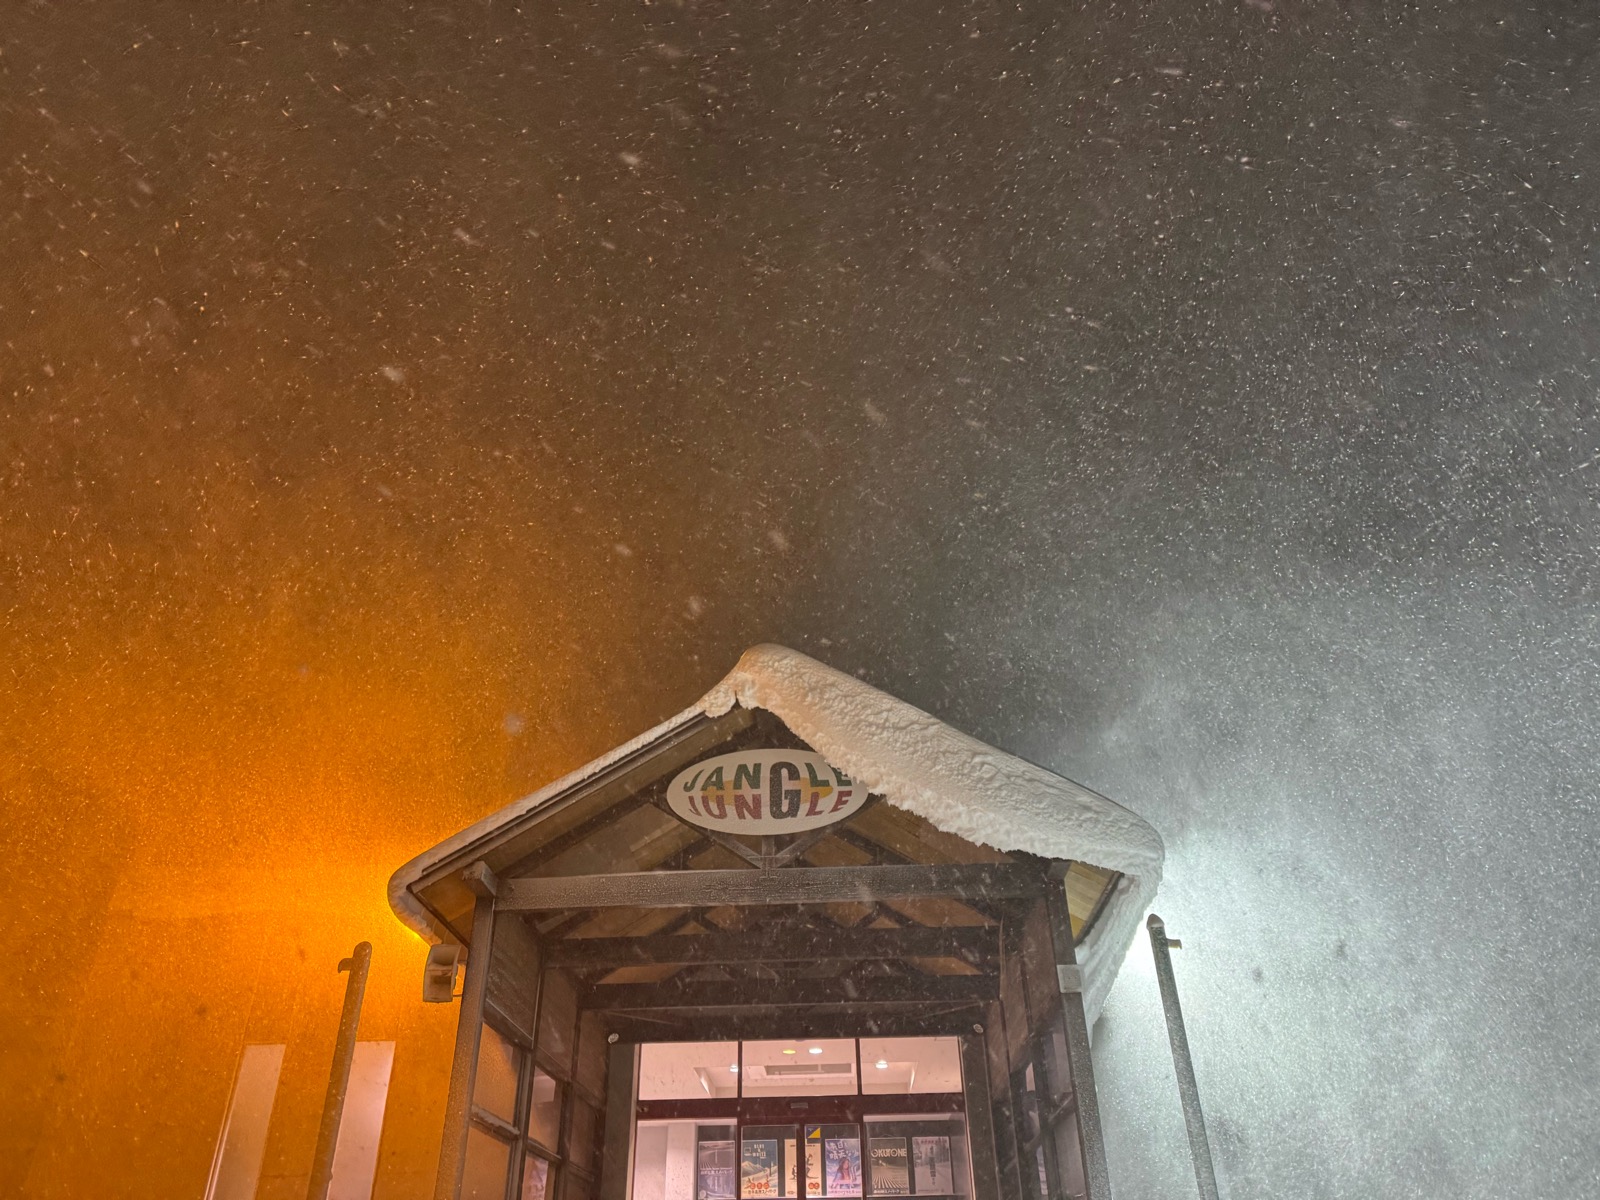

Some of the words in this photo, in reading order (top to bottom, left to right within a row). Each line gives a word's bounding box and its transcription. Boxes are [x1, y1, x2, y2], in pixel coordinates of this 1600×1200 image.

[683, 762, 852, 808] JANGLE
[688, 775, 852, 819] JUNGLE
[871, 1148, 907, 1158] OKUTONE
